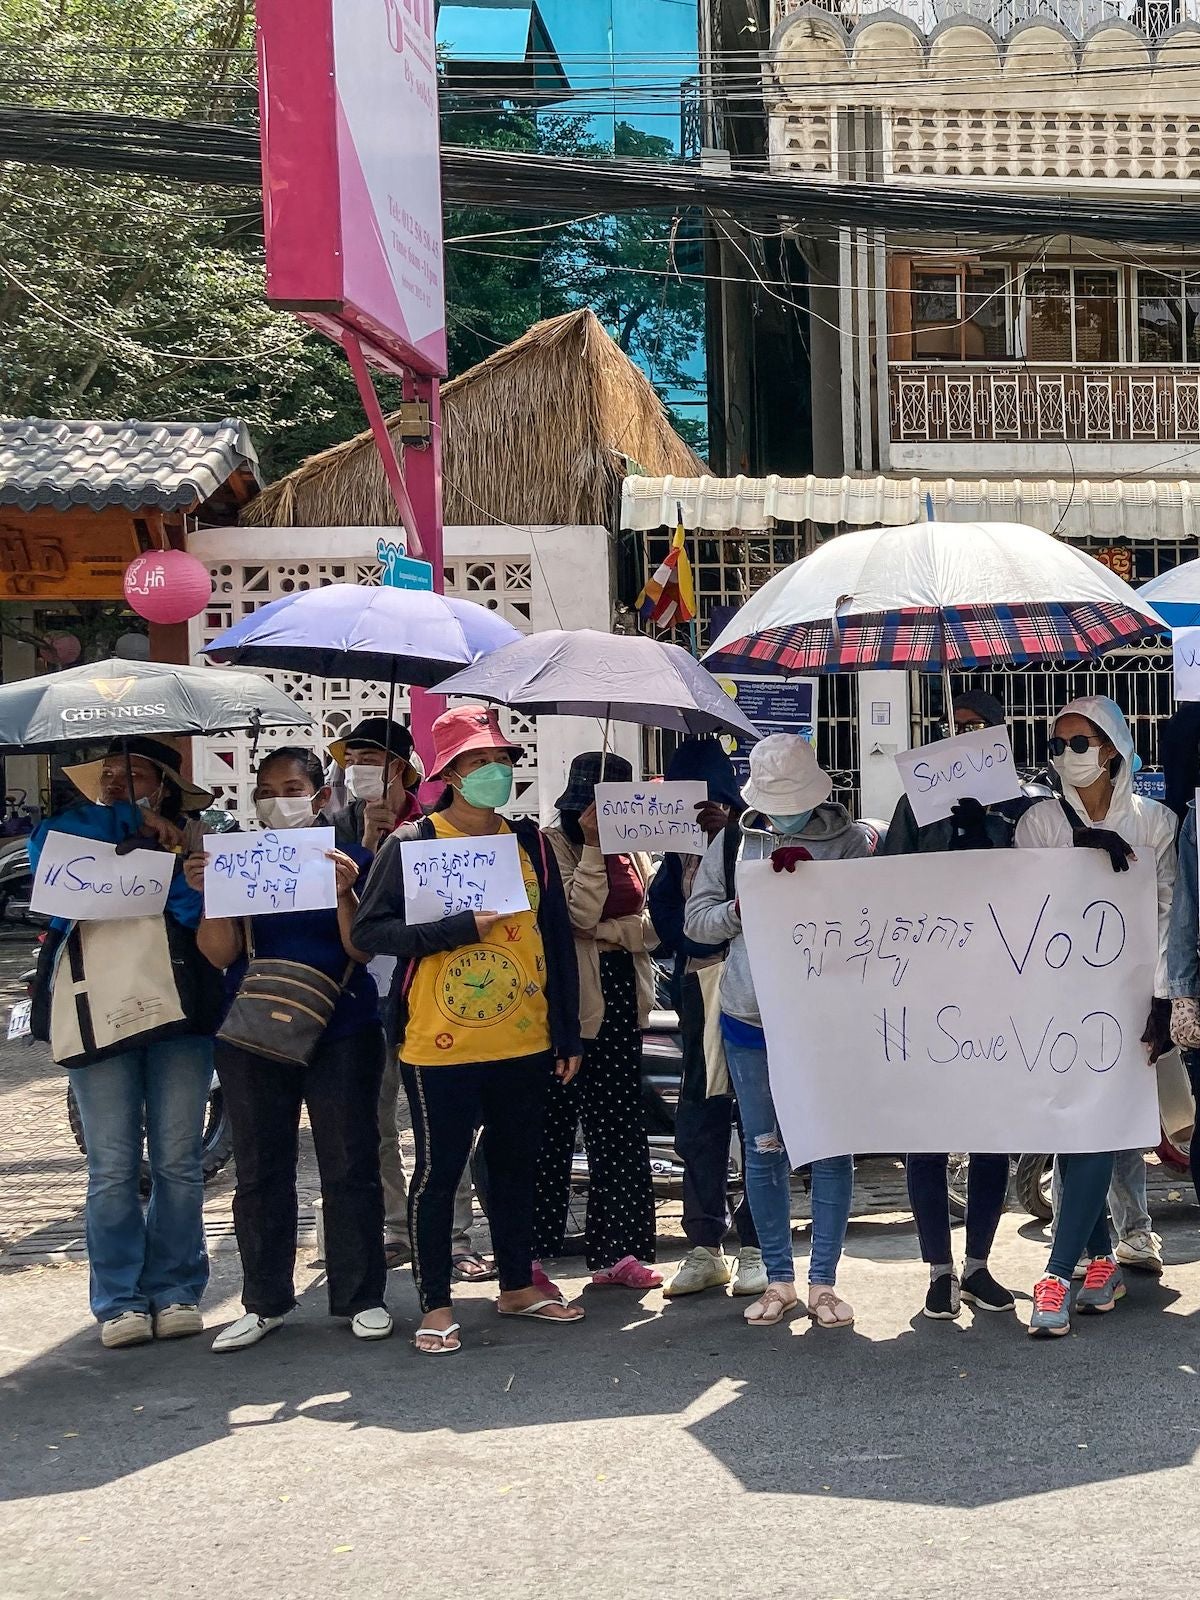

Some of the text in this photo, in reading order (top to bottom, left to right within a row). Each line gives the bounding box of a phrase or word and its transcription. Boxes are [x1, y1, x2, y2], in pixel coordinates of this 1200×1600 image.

[61, 703, 166, 721] GUINNESS
[913, 762, 967, 793] Save
[474, 952, 486, 960] 12
[491, 954, 496, 962] 1
[460, 959, 471, 967] 11
[502, 961, 508, 969] 2
[449, 968, 462, 977] 10
[511, 978, 517, 986] 3
[445, 983, 450, 991] 9
[507, 992, 514, 1000] 4
[448, 996, 454, 1005] 8
[460, 1006, 466, 1014] 7
[497, 1003, 503, 1012] 5
[478, 1010, 484, 1019] 6
